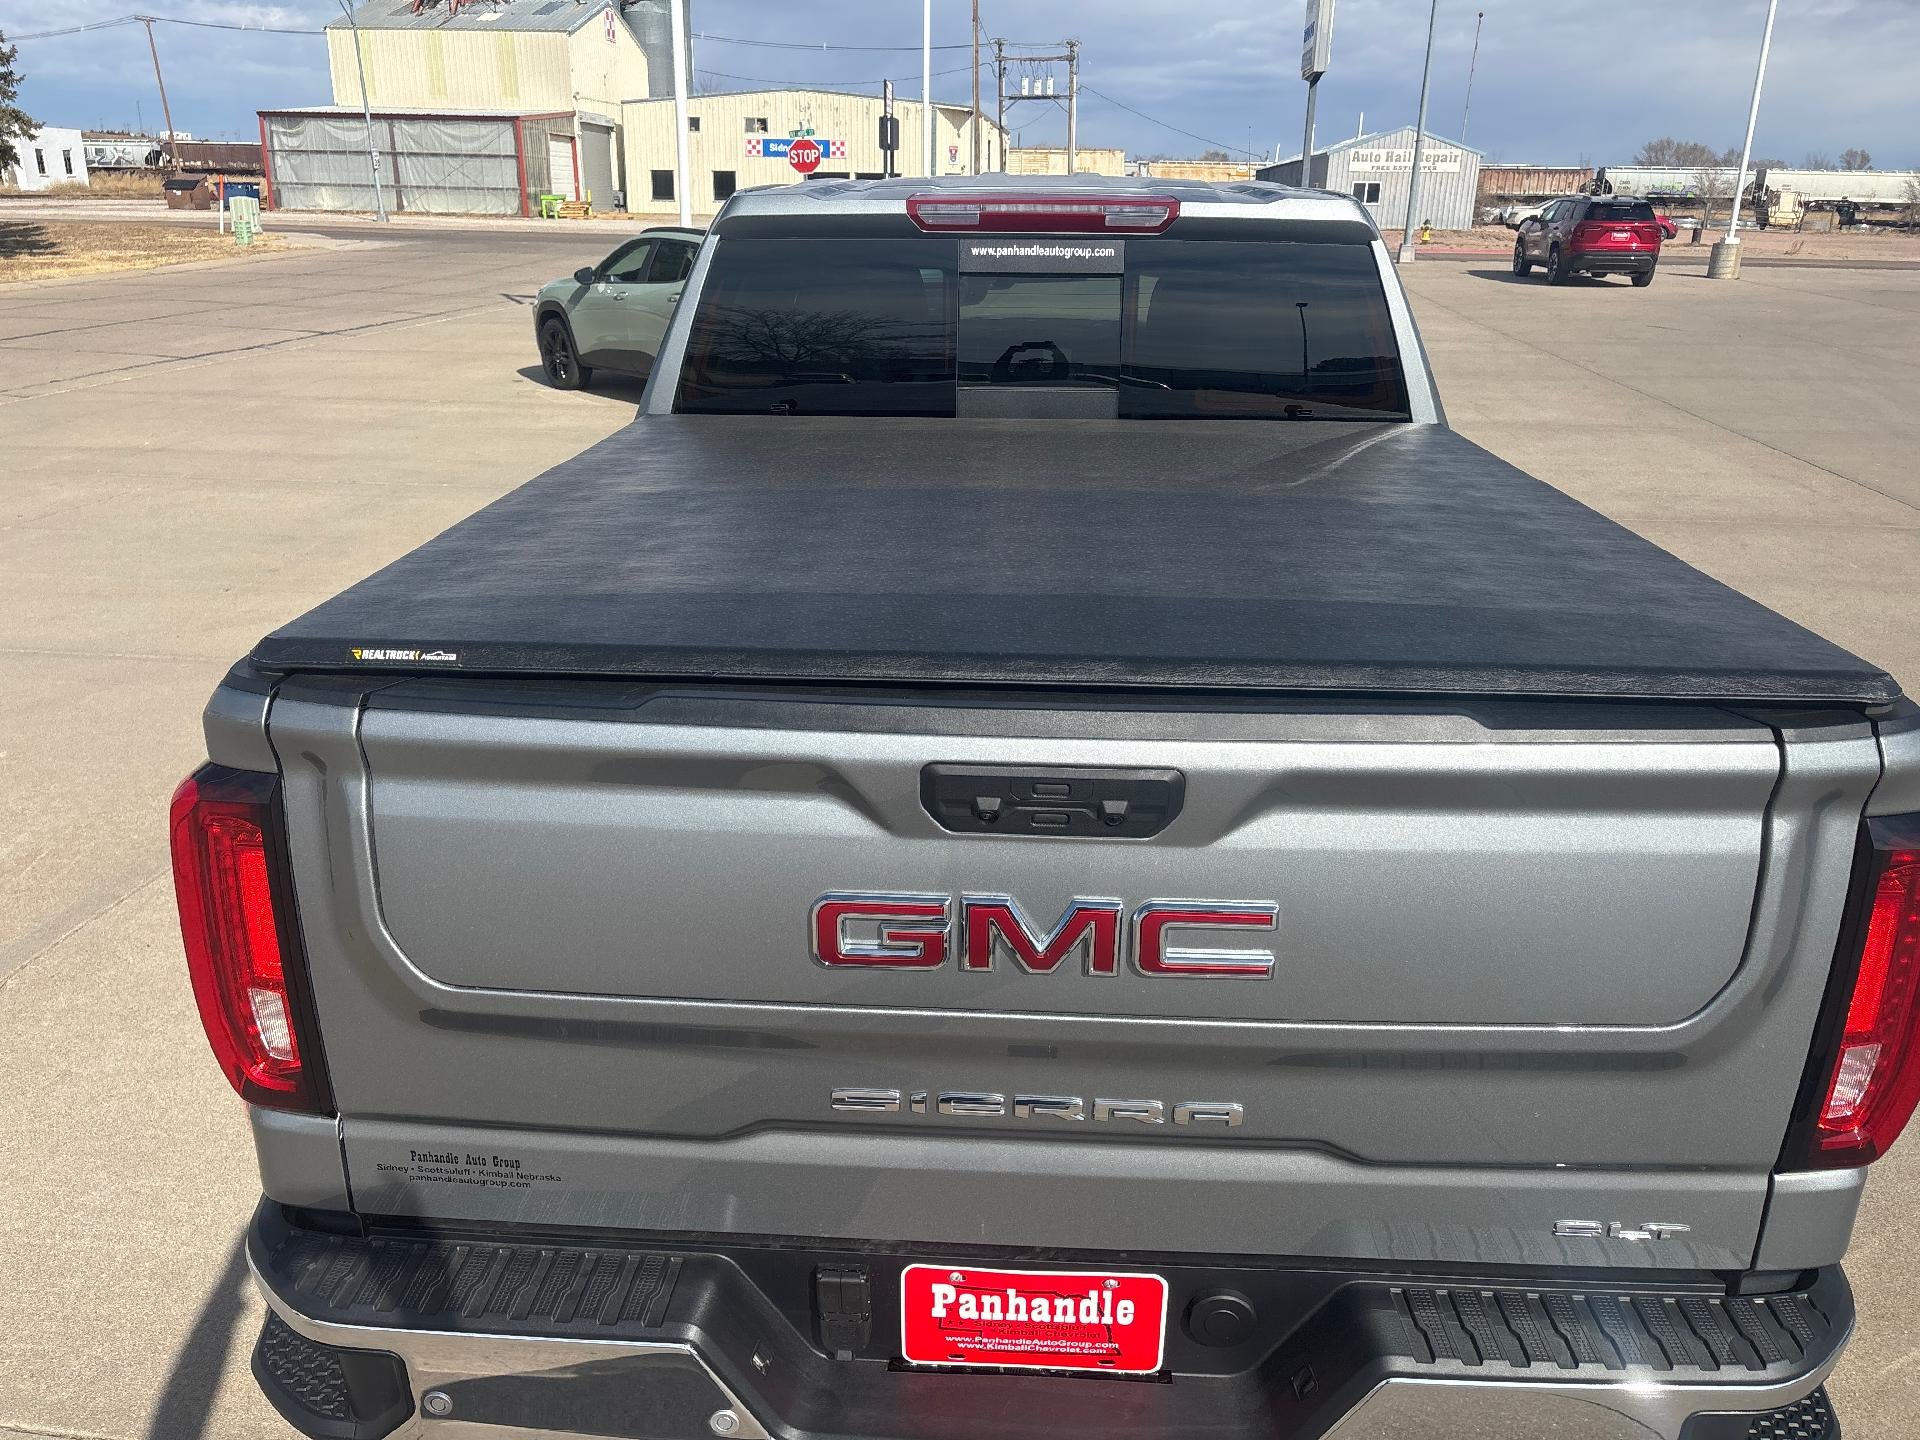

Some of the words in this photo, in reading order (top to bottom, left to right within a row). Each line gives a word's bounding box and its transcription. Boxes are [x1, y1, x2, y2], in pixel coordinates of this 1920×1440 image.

[790, 149, 819, 164] STOP
[1352, 151, 1381, 162] Auto
[1385, 151, 1412, 163] Hail
[1420, 151, 1460, 165] epair
[971, 245, 1115, 259] www.panhandleautogroup.com
[362, 649, 416, 660] REALTRUCK
[809, 890, 1279, 981] GMC
[831, 1087, 1244, 1127] SIERRA
[410, 1150, 459, 1164] Panhandle
[465, 1153, 487, 1166] Auto
[492, 1155, 520, 1170] Group
[376, 1163, 409, 1173] Sidney
[417, 1165, 471, 1175] Scottsbluff
[479, 1169, 514, 1179] Kimball
[516, 1172, 561, 1182] Nebraska
[409, 1175, 531, 1188] panhandleautogroup.com
[1553, 1219, 1690, 1241] SLT
[931, 1283, 1136, 1325] Panhandle
[974, 1320, 1013, 1329] Sidney
[945, 1336, 1119, 1349] www.PanhandleAutoGroup.com
[957, 1342, 1108, 1354] www.KimballChevrolet.com
